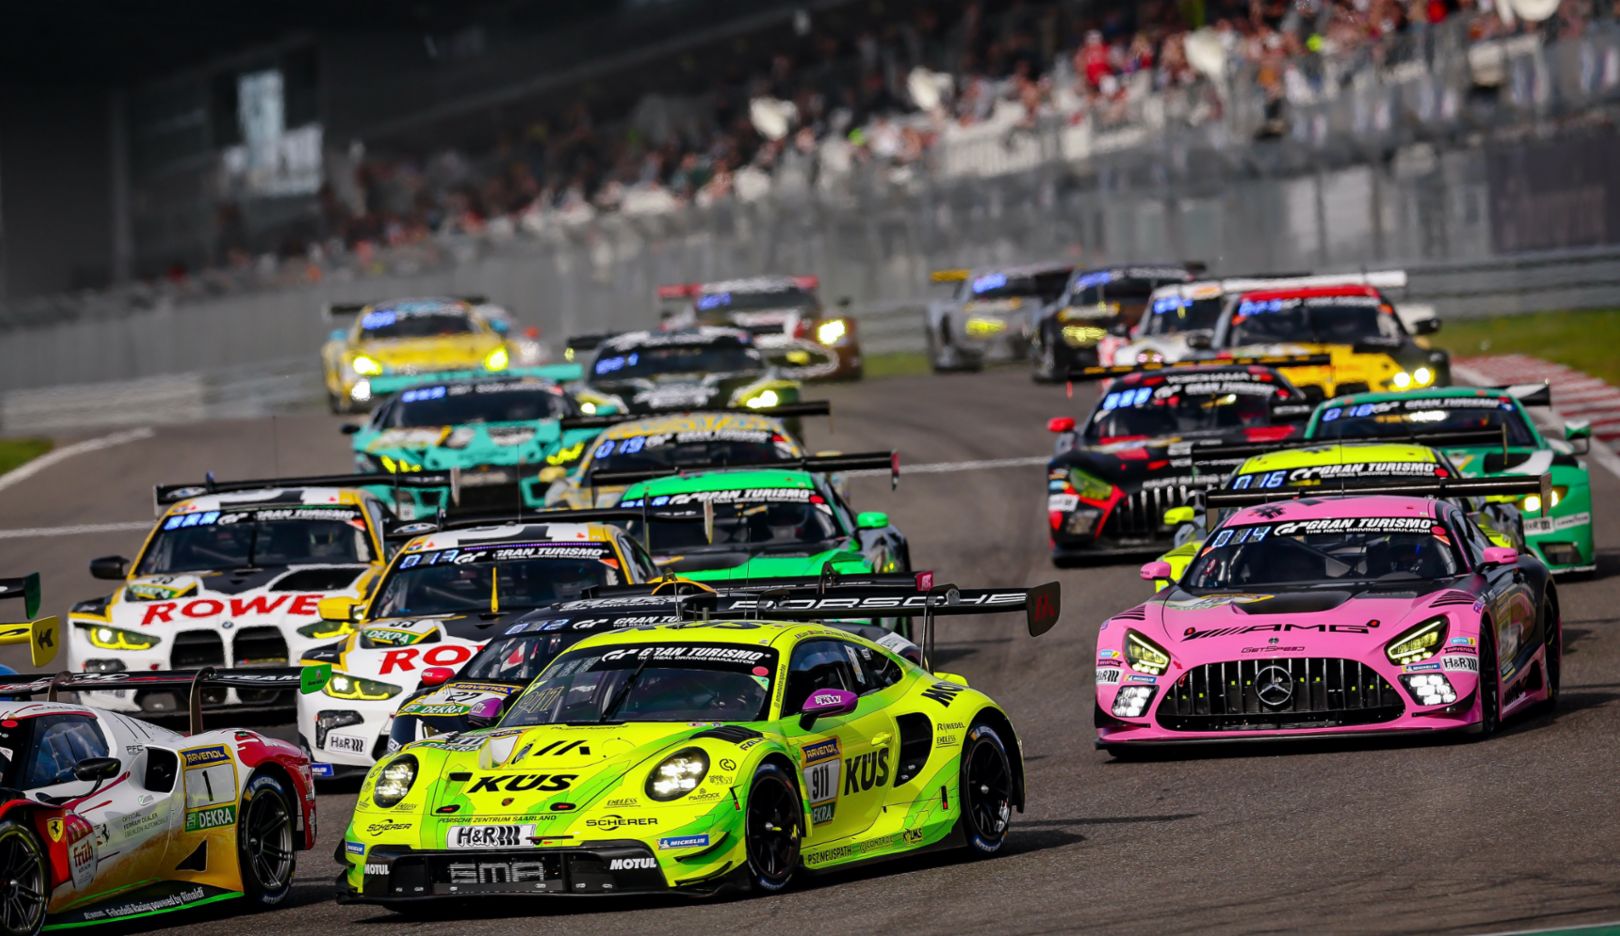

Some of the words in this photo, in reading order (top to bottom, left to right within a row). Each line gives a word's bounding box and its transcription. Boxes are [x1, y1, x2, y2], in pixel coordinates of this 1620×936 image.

[1368, 463, 1435, 473] TURISMO
[1306, 519, 1355, 530] GRAN
[1359, 518, 1431, 529] TURISMO
[1213, 526, 1272, 548] 014
[532, 548, 602, 556] TURISMO
[141, 595, 325, 626] ROWE
[613, 616, 657, 625] GRAN
[1244, 624, 1370, 634] AMG
[691, 647, 764, 661] TURISMO
[1443, 658, 1468, 669] H&R
[422, 705, 464, 714] DEKRA
[330, 736, 351, 749] H&R
[186, 749, 226, 763] RAVENOL
[806, 743, 837, 759] RAVENOL
[844, 747, 890, 797] KÜS
[202, 769, 214, 802] 1
[467, 774, 580, 793] KÜS
[812, 764, 830, 800] 911
[199, 807, 233, 828] DEKRA
[512, 814, 557, 822] SAARLAND
[586, 815, 659, 829] SCHERER
[457, 826, 497, 847] H&R
[669, 838, 706, 847] MICHELIN
[364, 863, 391, 875] MOTUL
[610, 857, 658, 870] MOTUL
